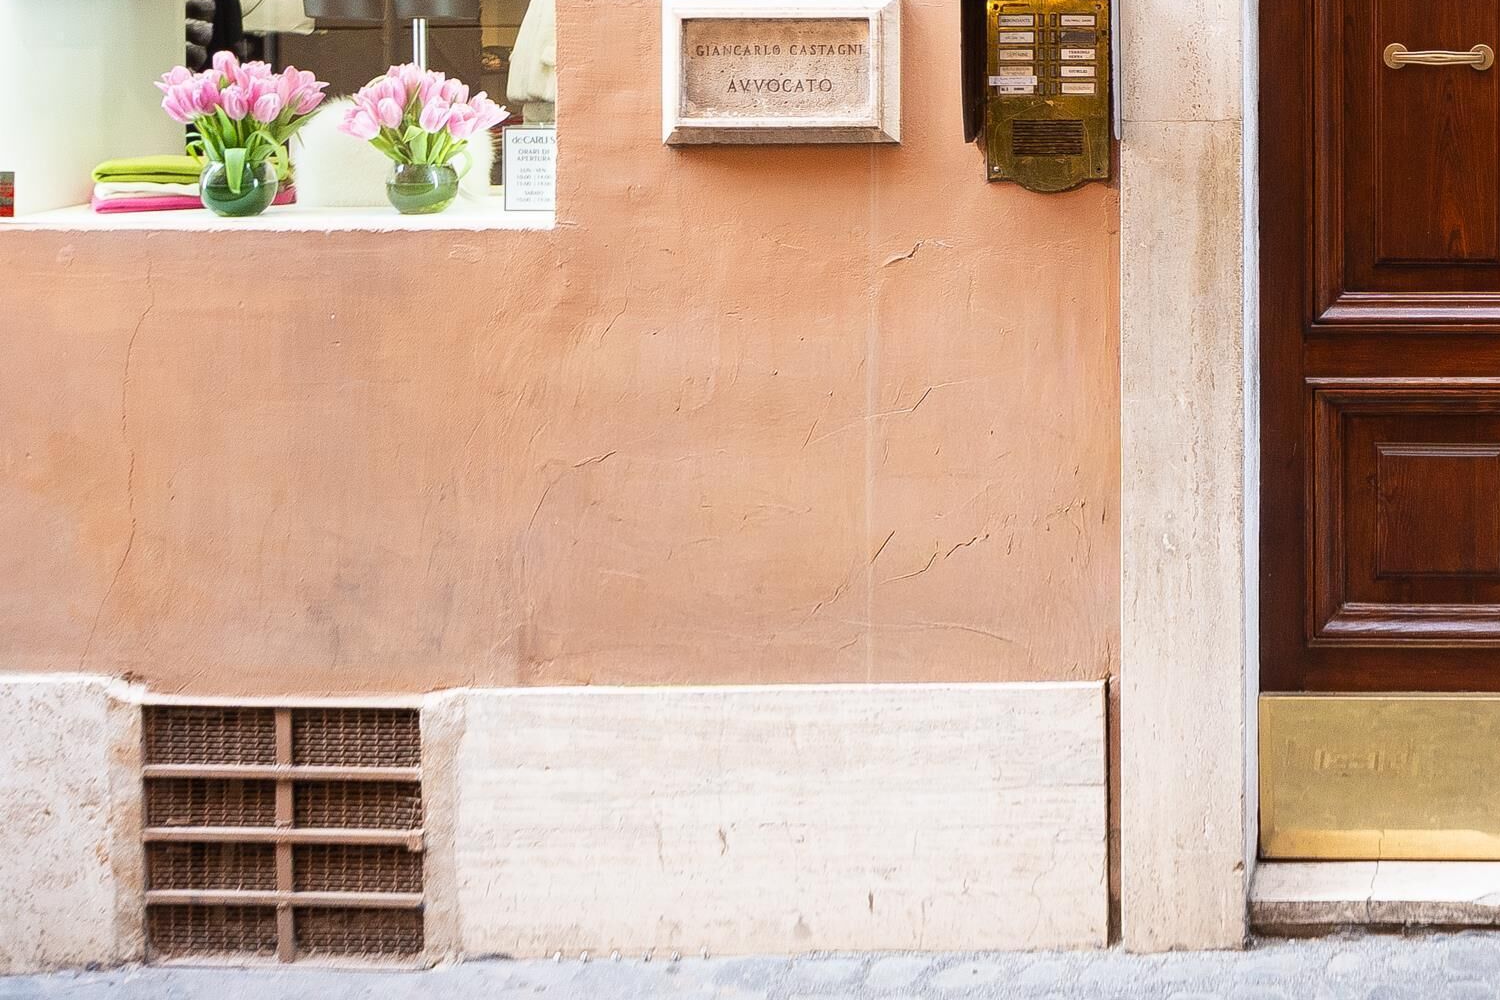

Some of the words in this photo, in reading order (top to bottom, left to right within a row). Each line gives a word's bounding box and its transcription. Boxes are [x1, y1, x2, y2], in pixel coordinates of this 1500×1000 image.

[696, 45, 781, 57] GIANCARLO
[789, 44, 863, 56] CASTAGNI
[727, 78, 833, 93] AVVOCATO
